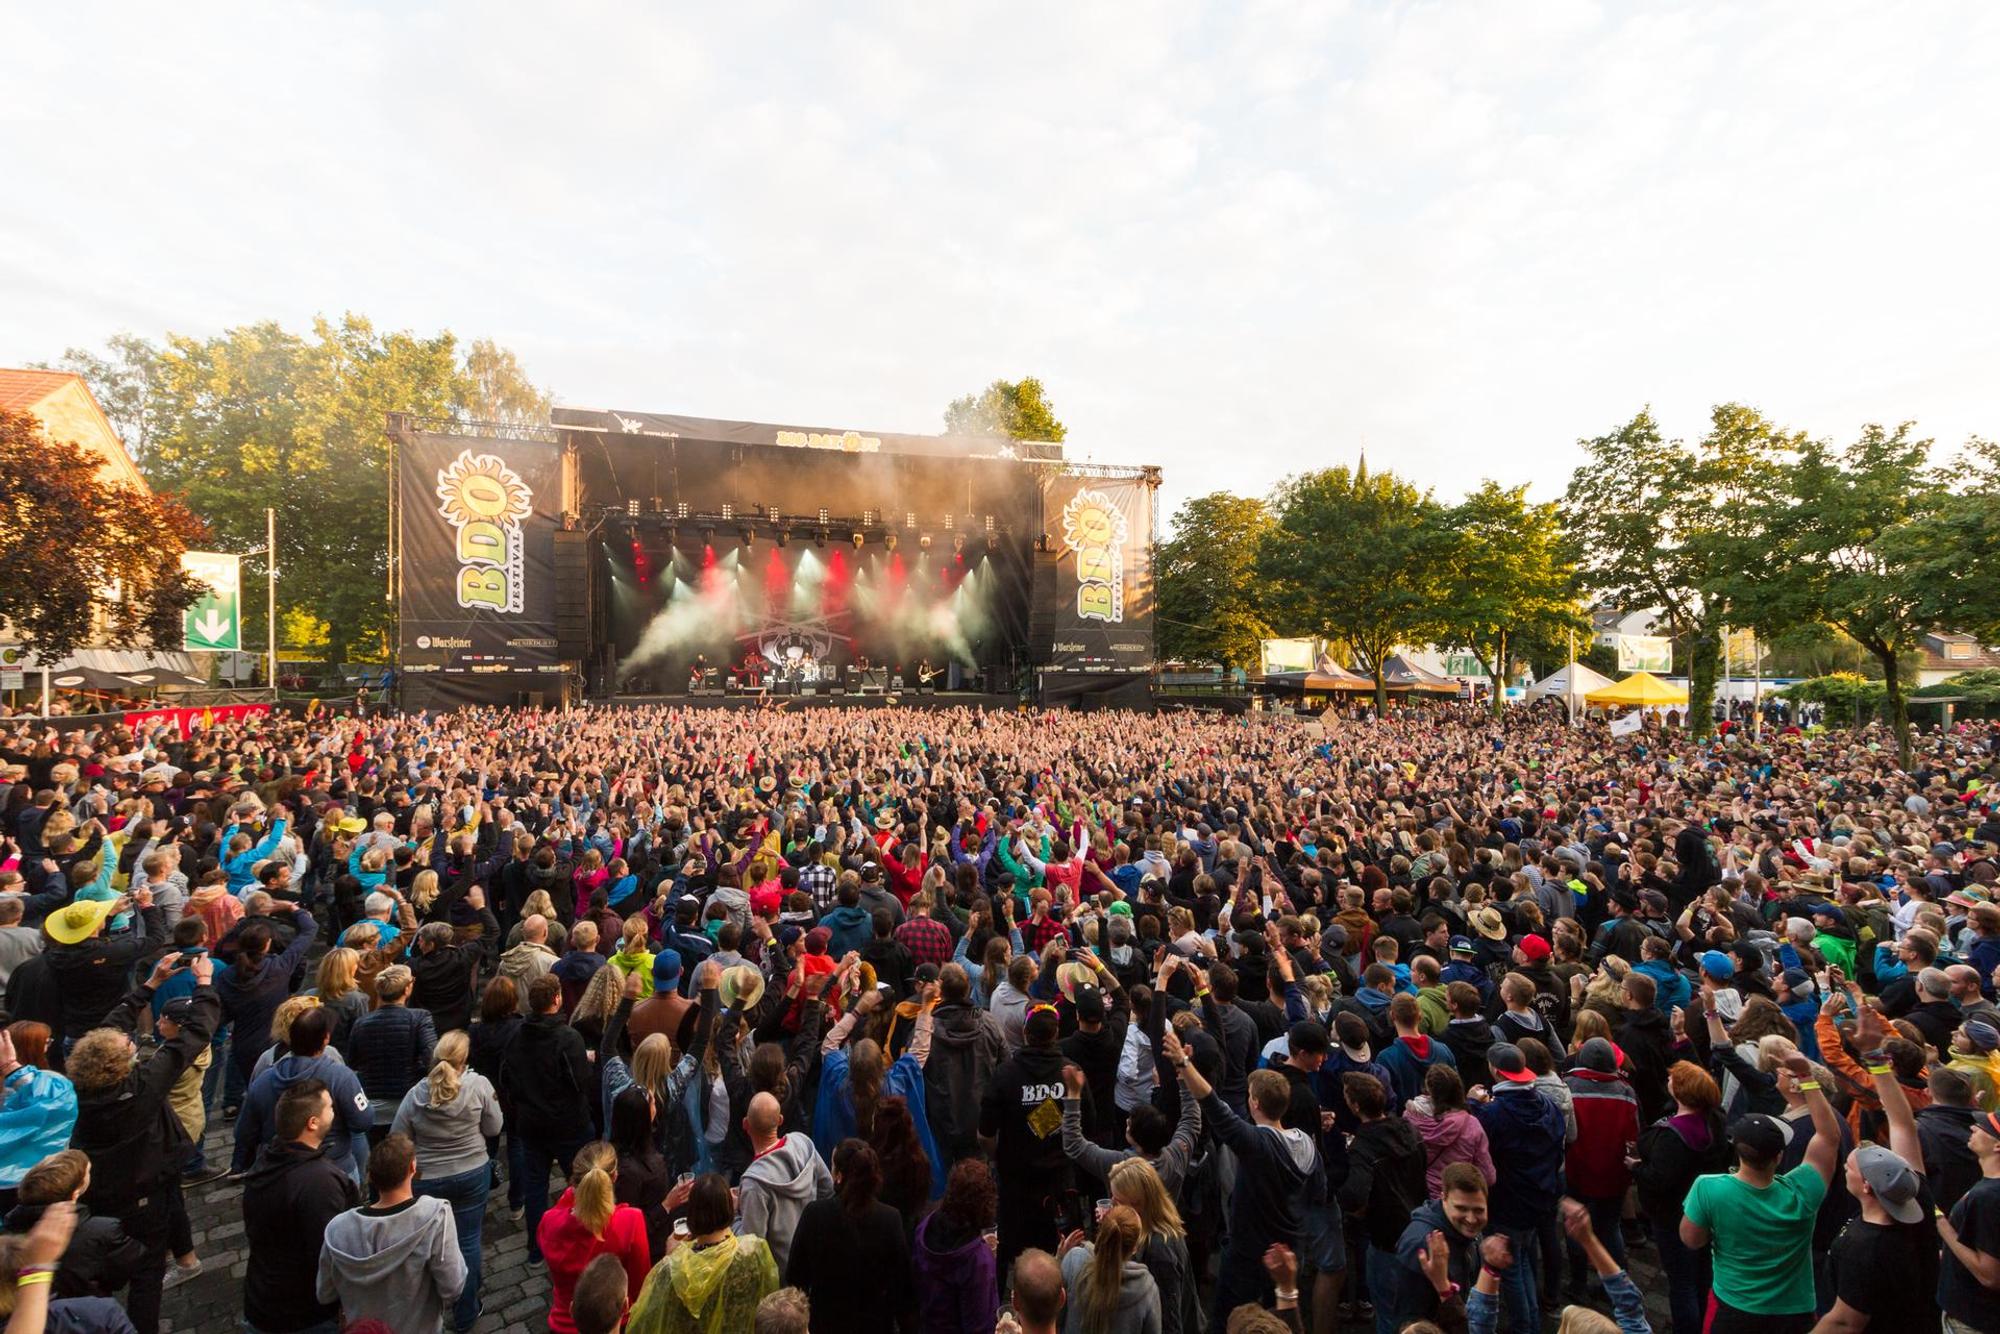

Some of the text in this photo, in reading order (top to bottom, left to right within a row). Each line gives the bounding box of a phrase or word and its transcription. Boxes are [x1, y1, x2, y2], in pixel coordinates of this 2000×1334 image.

[461, 473, 508, 608] BDO
[512, 533, 520, 609] FESTIVAL
[1079, 507, 1113, 618] BDO
[432, 636, 472, 649] Warsteiner
[1021, 1082, 1064, 1101] BDO
